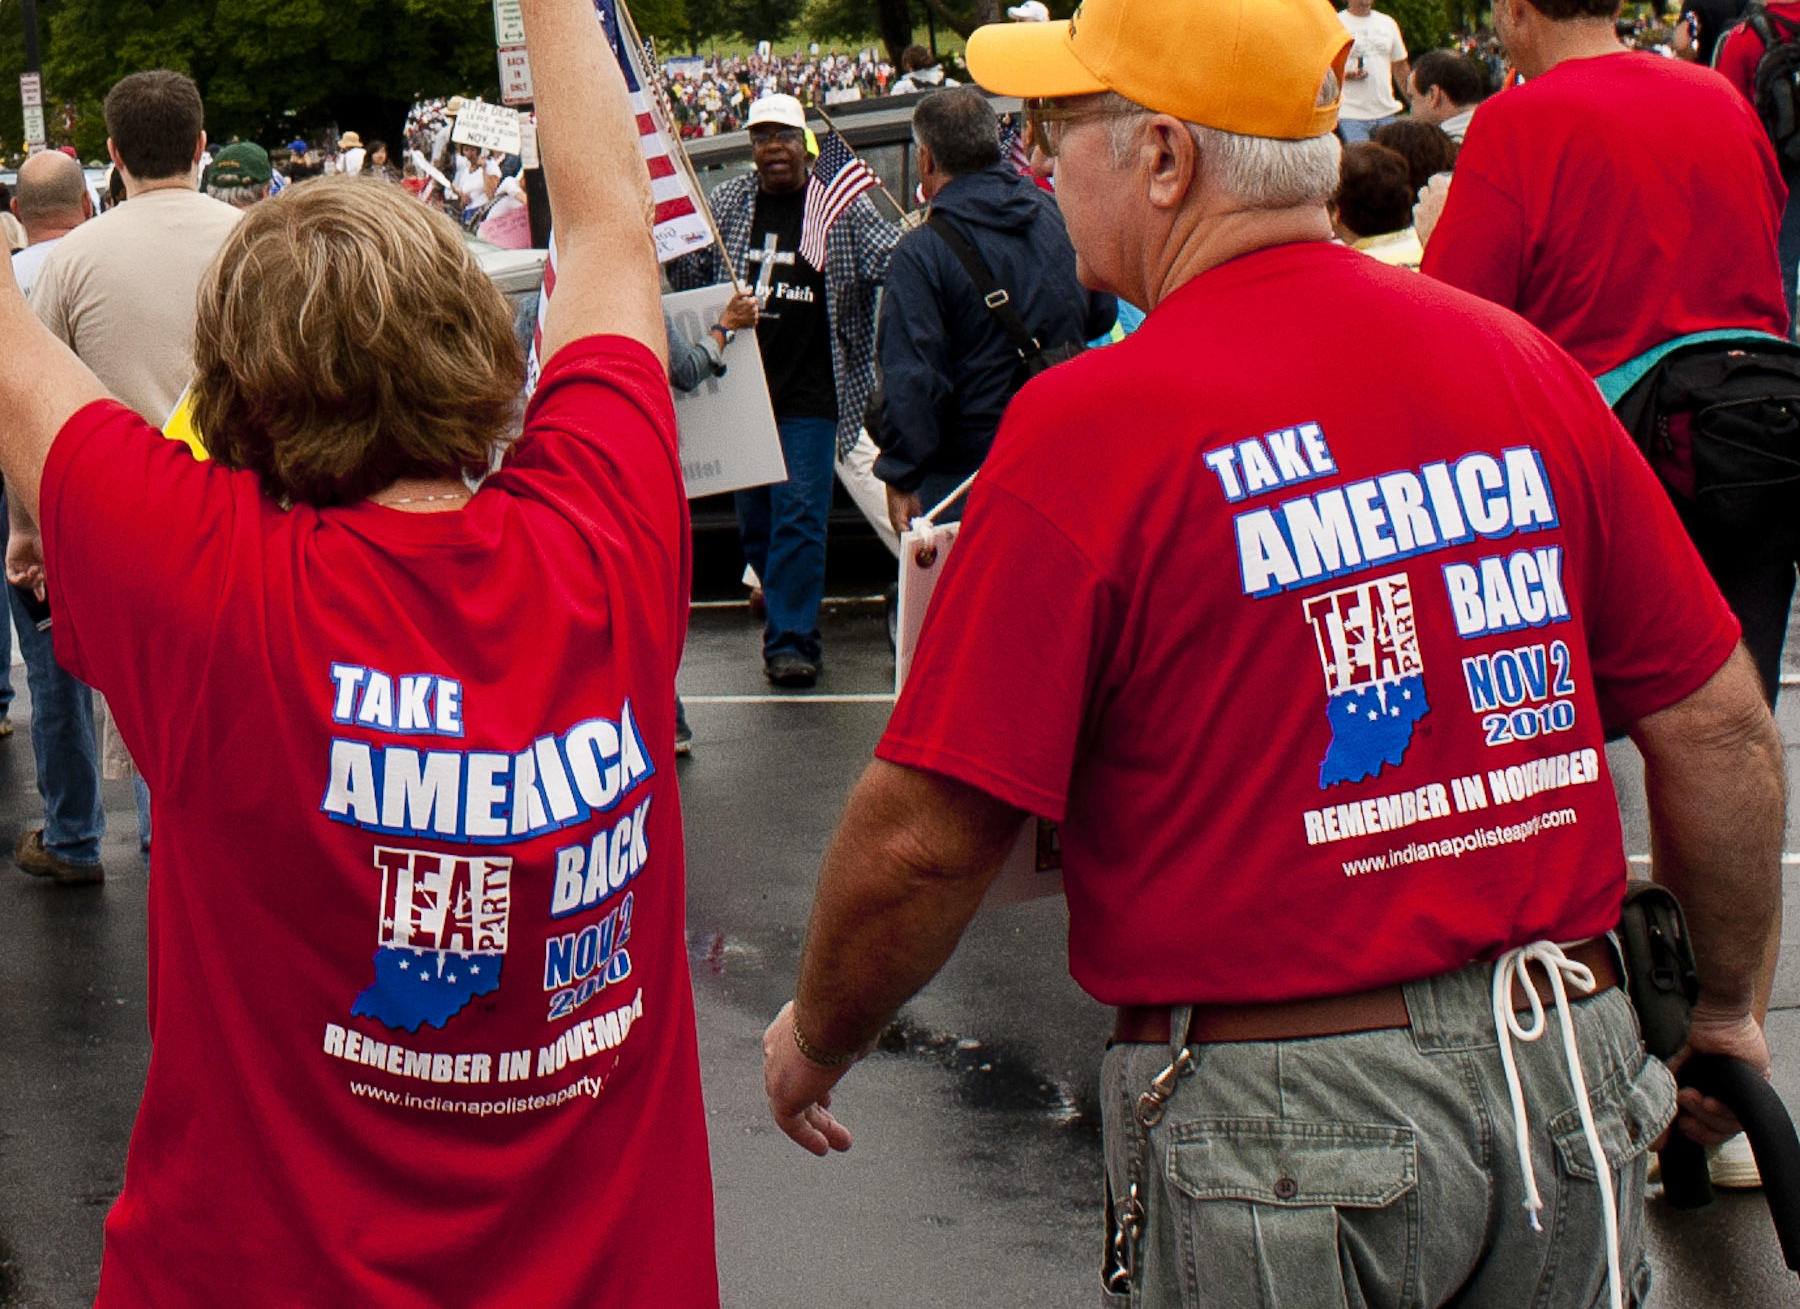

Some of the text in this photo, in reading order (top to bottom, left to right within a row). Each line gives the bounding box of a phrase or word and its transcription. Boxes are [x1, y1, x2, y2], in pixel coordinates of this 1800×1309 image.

[776, 281, 814, 304] Faith
[1203, 420, 1339, 503] TAKE
[1233, 445, 1560, 599] AMERICA
[1388, 582, 1421, 674] PARTY
[1442, 544, 1571, 639] BACK
[1302, 583, 1402, 696] TEA
[1462, 639, 1576, 713] NOV 2
[331, 661, 465, 738] TAKE
[1482, 699, 1576, 747] 2010
[320, 697, 656, 845] AMERICA
[1303, 747, 1600, 846] REMEMBER IN NOVEMBER
[374, 845, 476, 953] TEA
[549, 793, 653, 920] BACK
[478, 860, 510, 951] PARTY
[543, 890, 635, 991] NOV 2
[546, 948, 633, 1022] 2010
[323, 1022, 492, 1083] REMEMBER
[498, 1049, 531, 1082] IN
